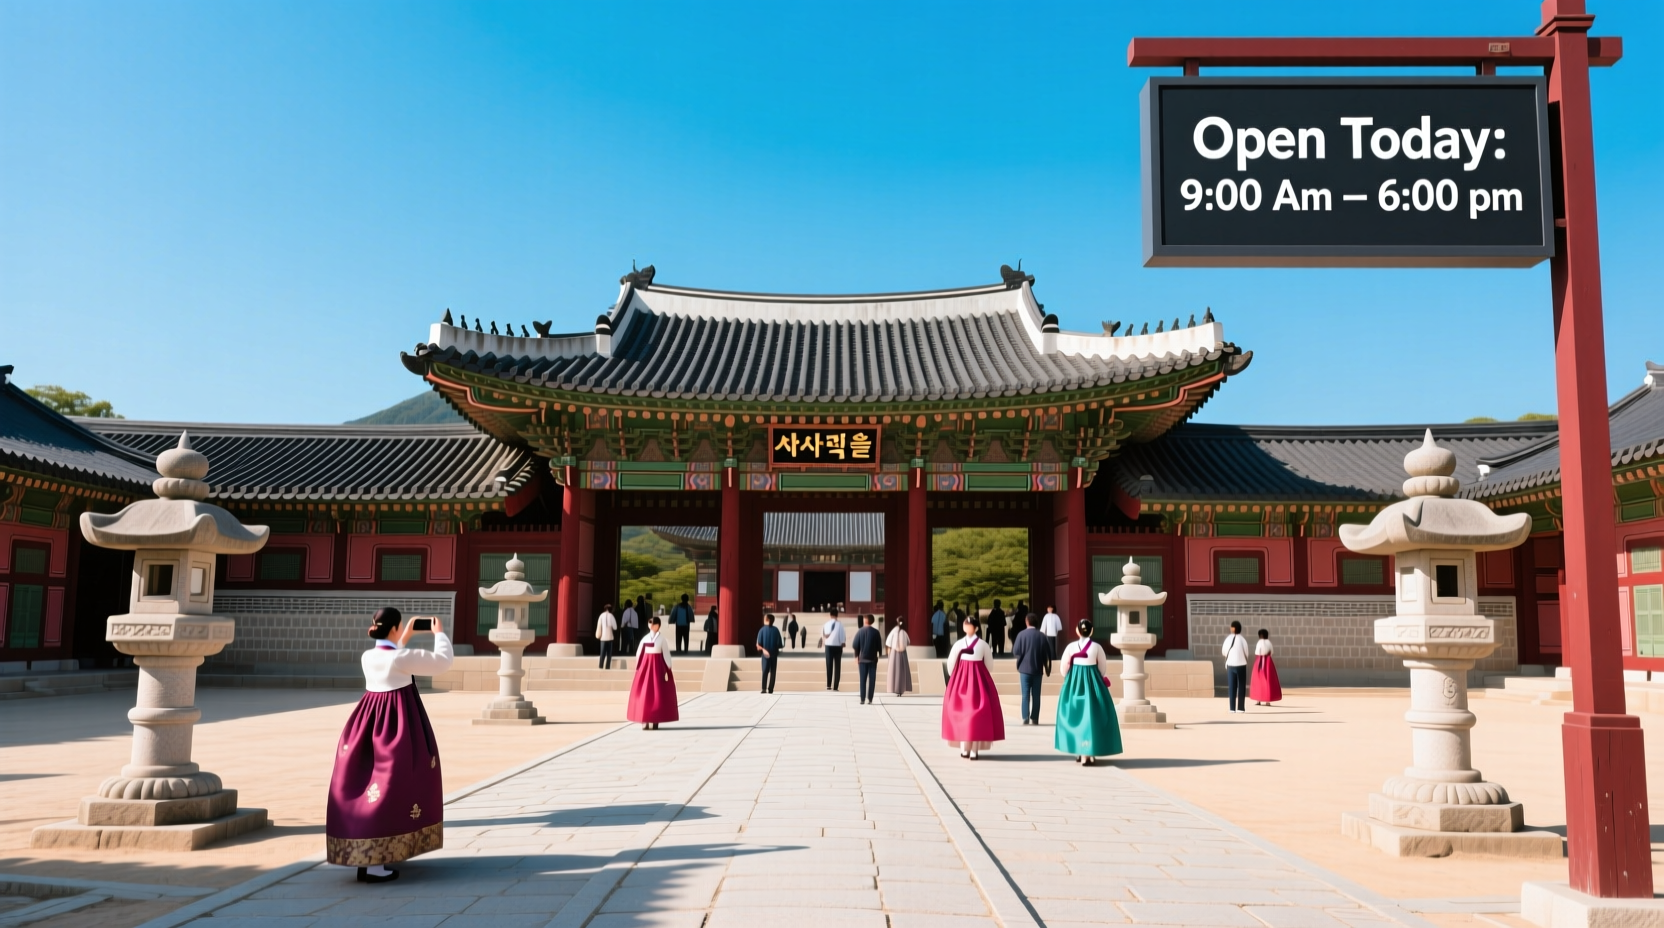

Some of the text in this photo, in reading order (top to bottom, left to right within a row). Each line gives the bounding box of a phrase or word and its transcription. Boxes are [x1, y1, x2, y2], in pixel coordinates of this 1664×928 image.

[1192, 115, 1506, 172] Open Today:
[1180, 178, 1263, 212] 9:00
[1271, 178, 1333, 211] Am
[1377, 178, 1459, 212] 6:00
[1469, 188, 1523, 220] pm
